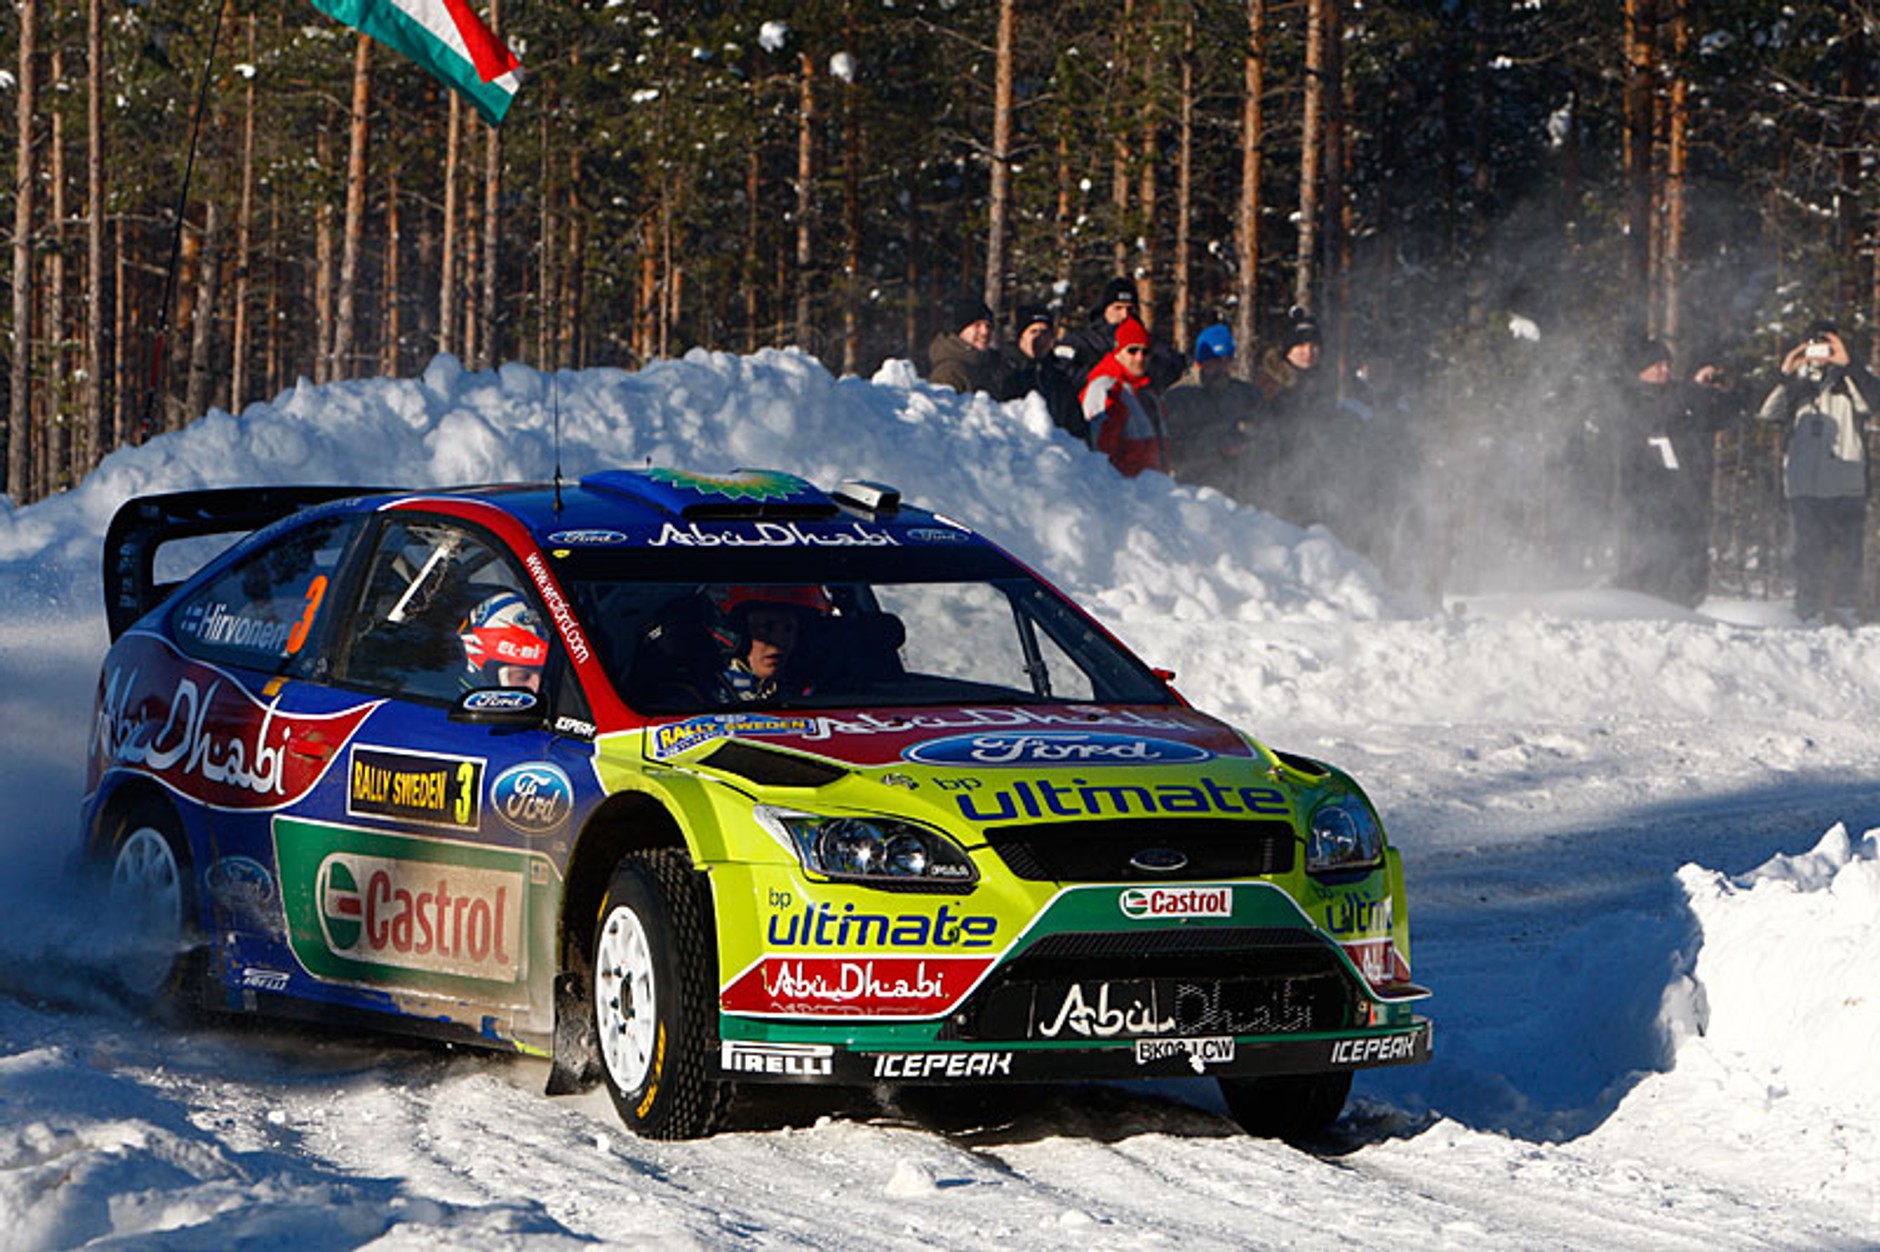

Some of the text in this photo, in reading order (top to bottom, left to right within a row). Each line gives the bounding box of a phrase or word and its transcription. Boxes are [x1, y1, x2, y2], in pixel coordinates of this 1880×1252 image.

[197, 601, 287, 650] Hirvonen
[286, 575, 328, 655] 3
[526, 552, 589, 664] www.wrcford.com
[475, 692, 523, 707] Ford
[660, 722, 717, 750] RALLY
[724, 720, 805, 731] SWEDEN
[970, 734, 1163, 763] Ford
[353, 761, 474, 823] RALLY SWEDEN 3
[507, 773, 561, 822] Ford
[931, 777, 982, 791] bp
[957, 777, 1290, 822] ultimate
[769, 887, 792, 909] bp
[1151, 889, 1228, 915] Castrol
[366, 869, 509, 964] Castrol
[768, 902, 998, 946] ultimate
[721, 1040, 833, 1076] PIRELLI
[874, 1052, 1013, 1078] ICEPEAK
[1331, 1036, 1416, 1064] ICEPEAK
